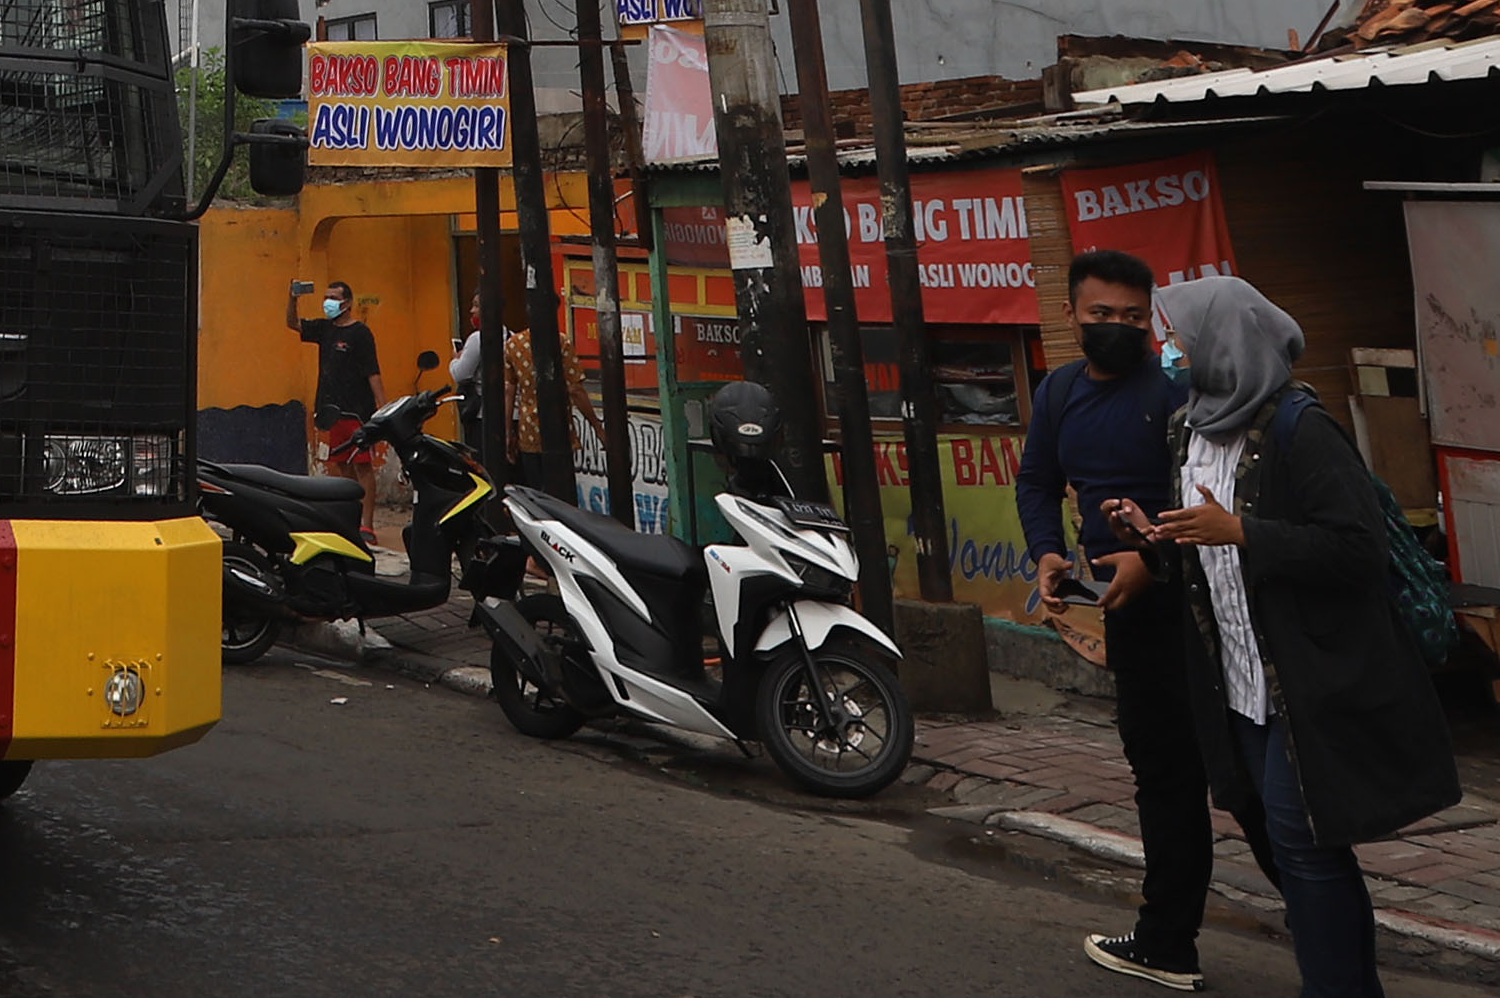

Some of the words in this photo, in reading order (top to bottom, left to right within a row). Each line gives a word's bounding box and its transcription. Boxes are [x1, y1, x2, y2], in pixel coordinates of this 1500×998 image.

[310, 55, 378, 96] BAKSO
[383, 55, 442, 97] BANG
[445, 56, 505, 98] TIMIN
[312, 104, 369, 148] ASLI
[375, 105, 505, 150] WONOGIRI
[952, 196, 1028, 240] TIMI
[1074, 169, 1210, 222] BAKSO
[918, 263, 955, 288] ASLI
[957, 262, 1036, 288] WONOG
[950, 437, 1023, 486] BAN
